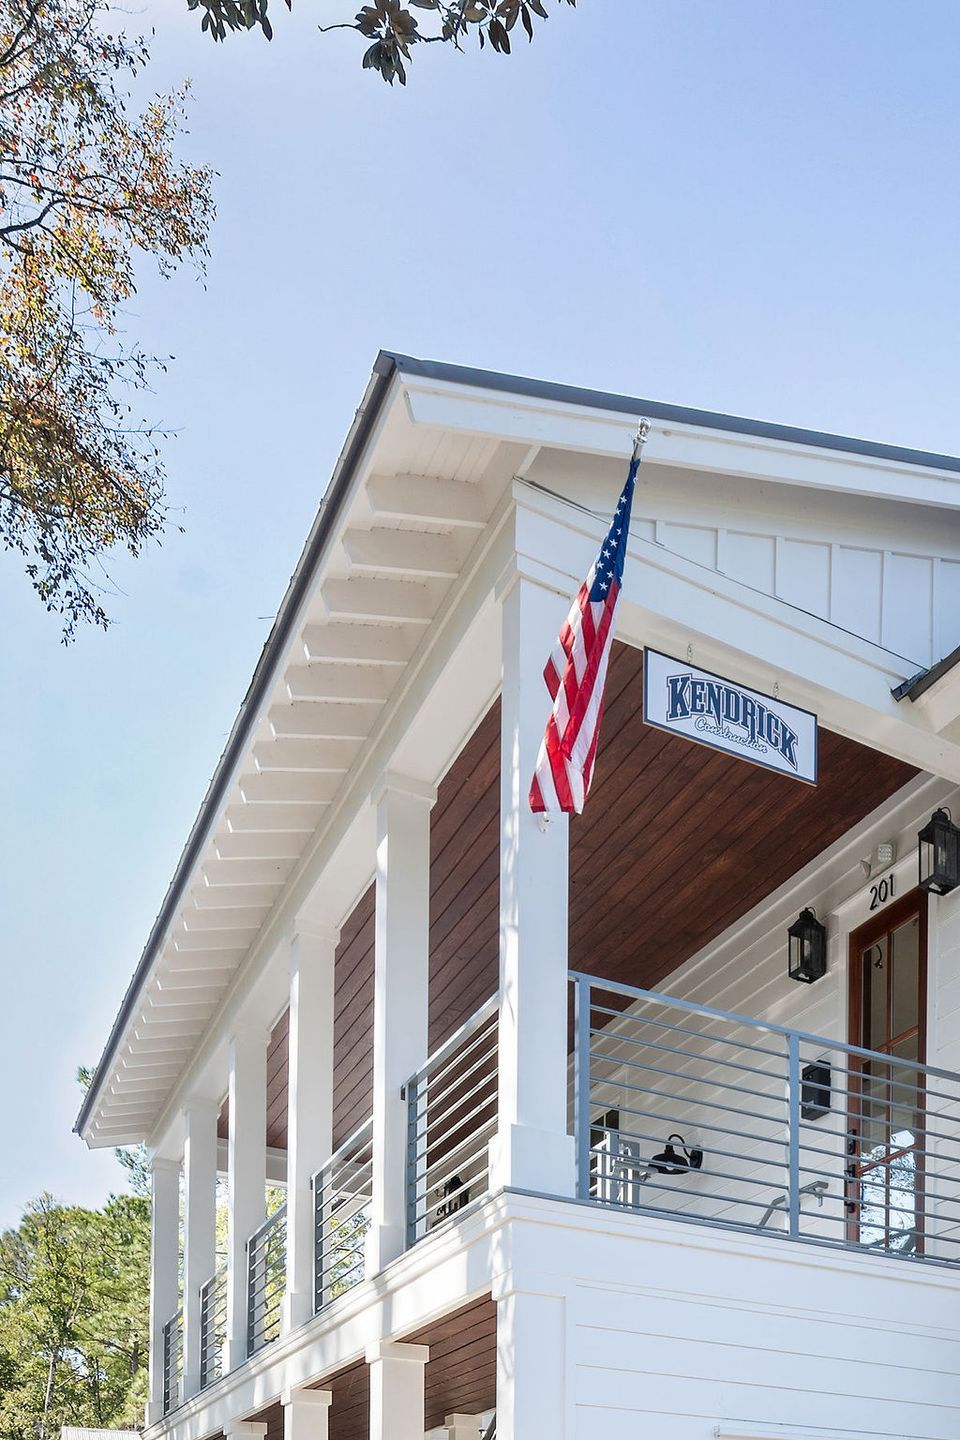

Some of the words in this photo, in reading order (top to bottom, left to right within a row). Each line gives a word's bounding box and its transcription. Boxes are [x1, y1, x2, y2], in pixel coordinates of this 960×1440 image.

[666, 673, 798, 771] KENDRICK
[695, 714, 767, 753] Construction
[869, 873, 895, 911] 201
